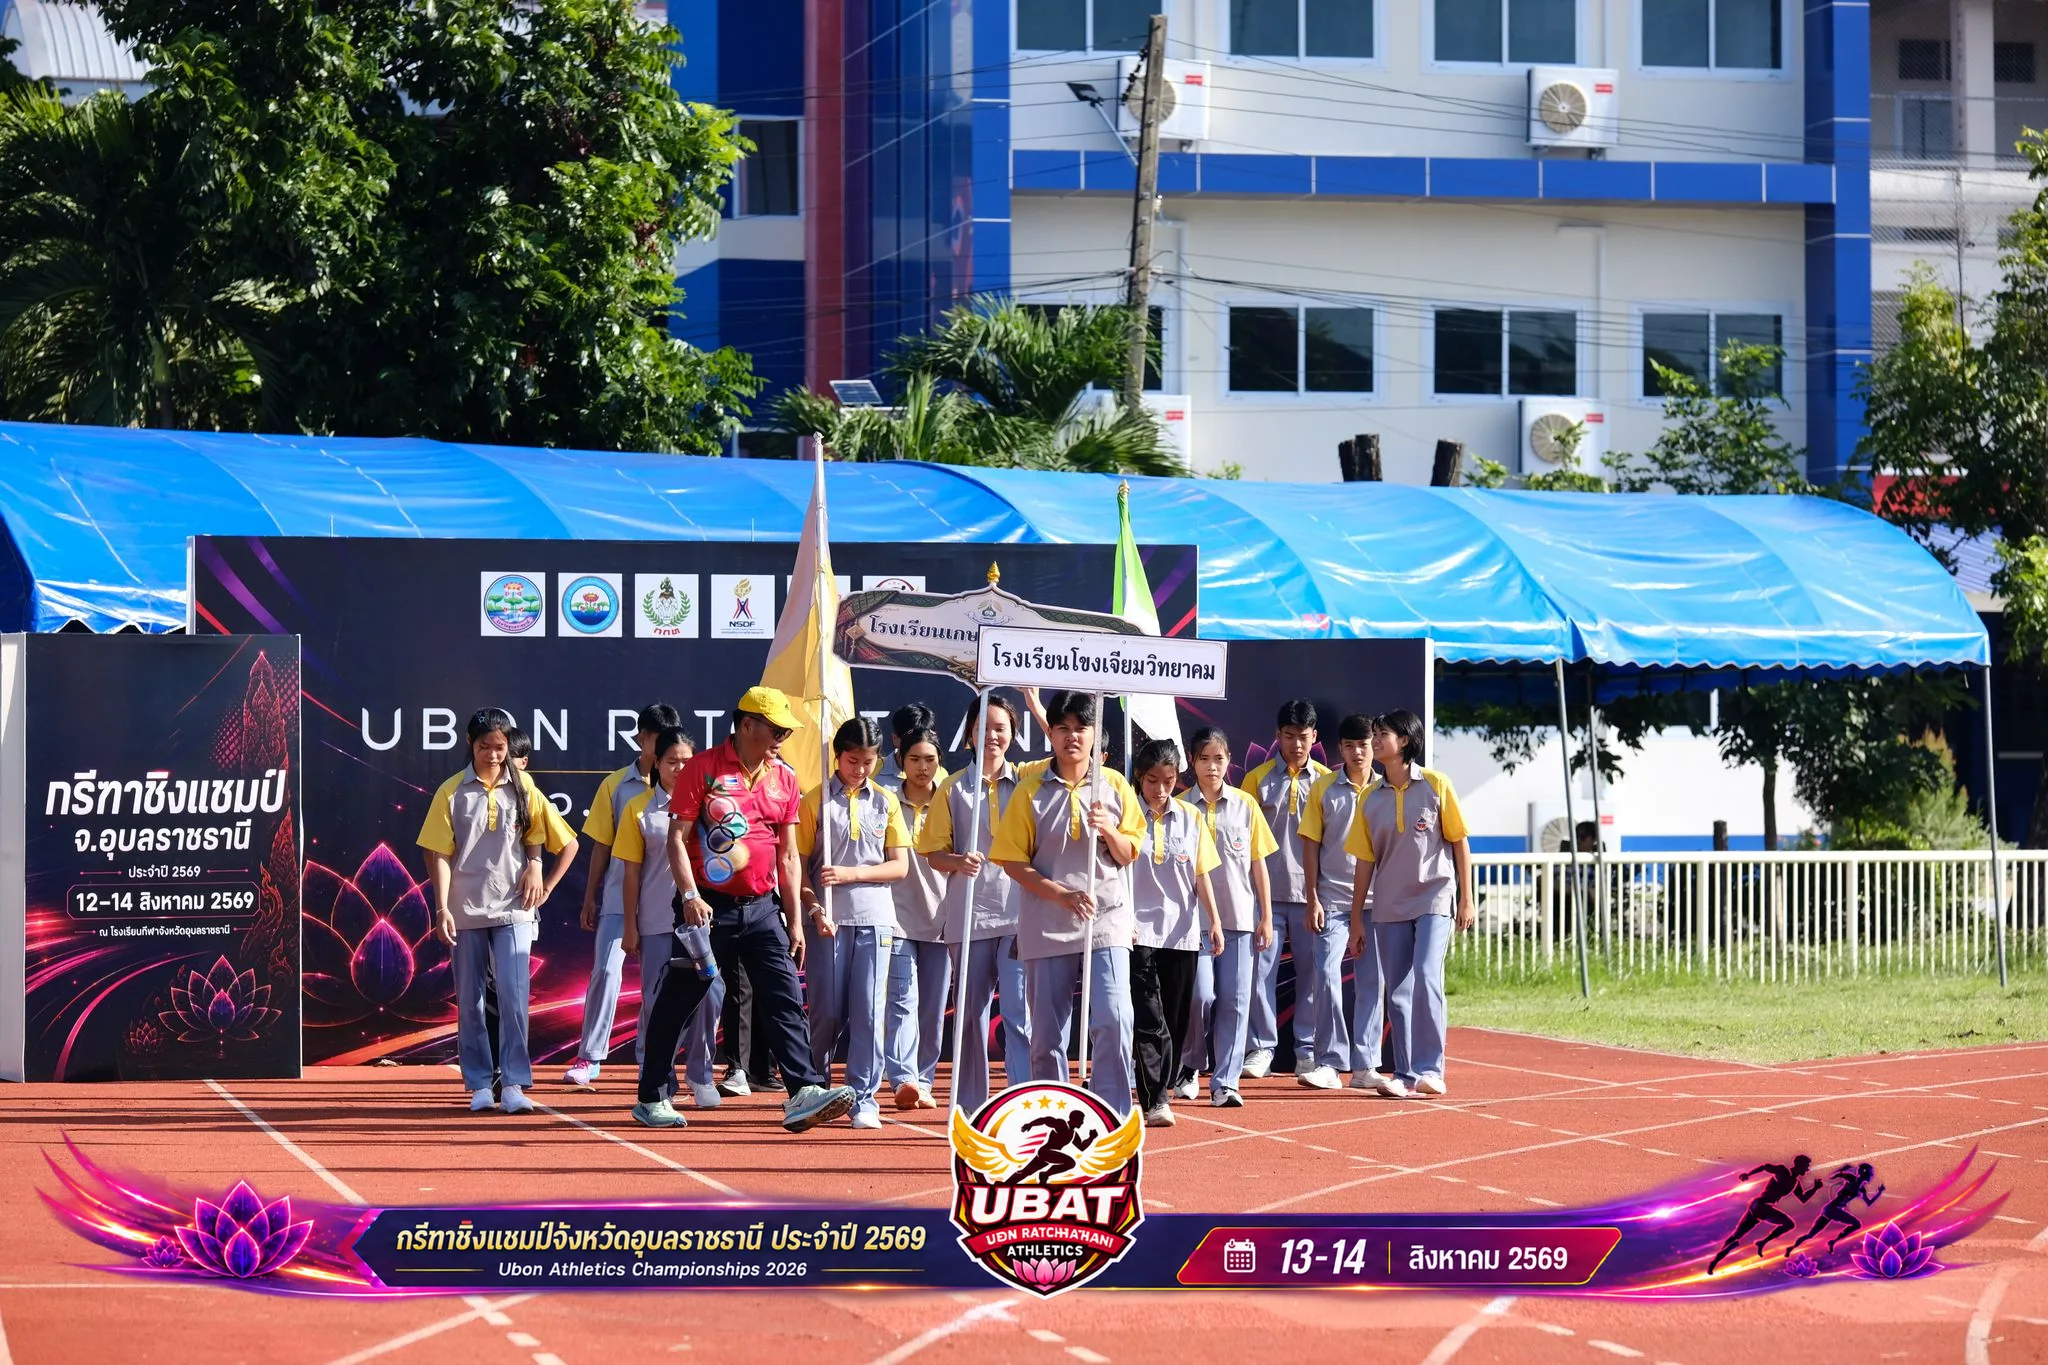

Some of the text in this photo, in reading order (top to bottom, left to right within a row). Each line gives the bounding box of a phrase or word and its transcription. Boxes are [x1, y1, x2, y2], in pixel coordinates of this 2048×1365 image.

[992, 643, 1215, 680] โรงเรียนโขงเจียมวิทยาคม
[45, 769, 286, 815] กรีฑาชิงแชมป์
[74, 818, 252, 861] จ.อุบลราชธานี
[128, 864, 201, 878] ประจำปี 2569
[139, 891, 205, 911] สิงหาคม
[210, 891, 255, 910] 2569
